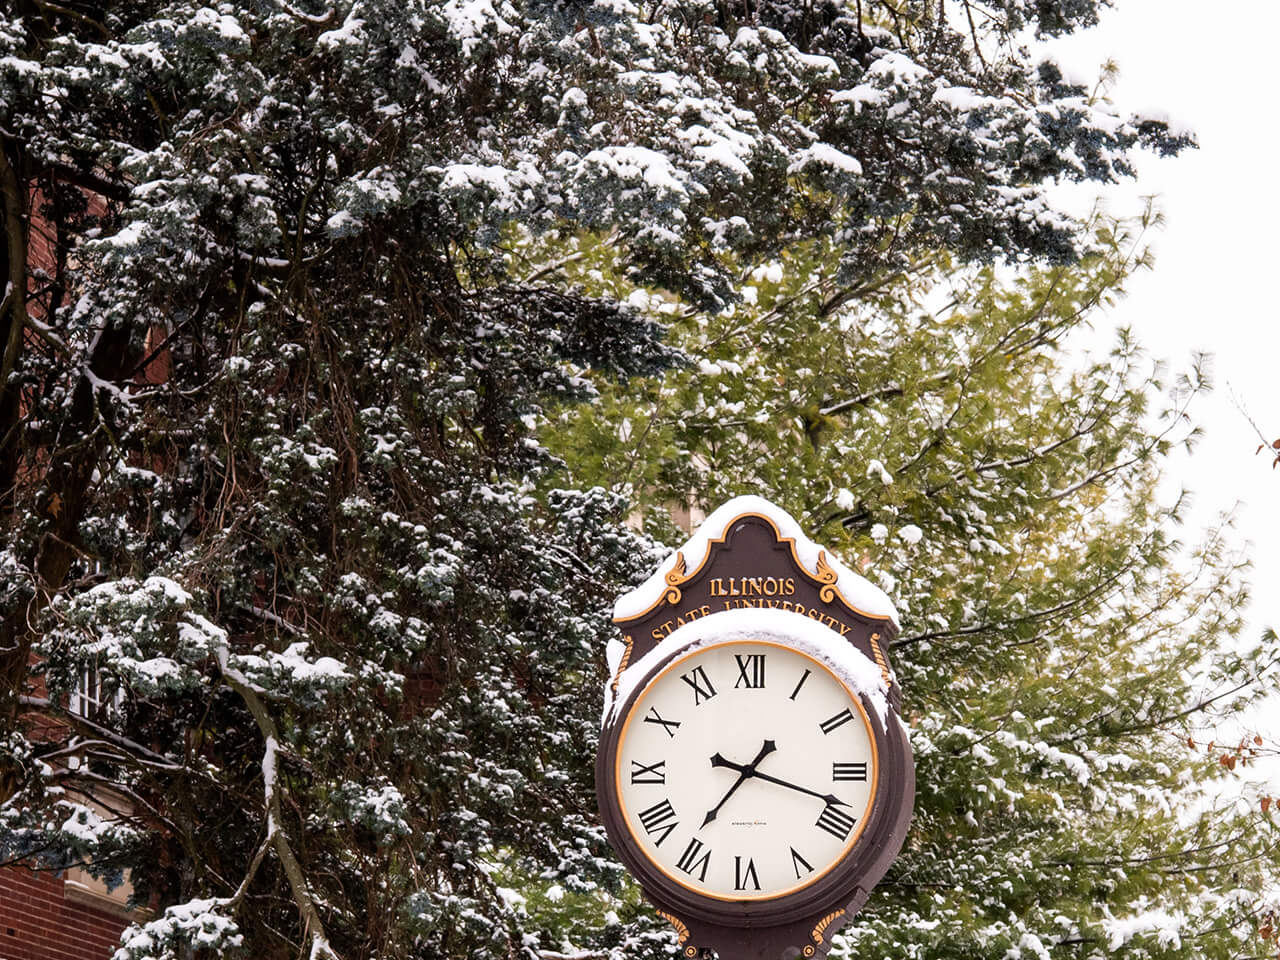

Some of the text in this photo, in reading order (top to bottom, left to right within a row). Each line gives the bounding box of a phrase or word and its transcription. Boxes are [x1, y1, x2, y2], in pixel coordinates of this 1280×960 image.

[709, 577, 796, 597] ILLINOIS
[651, 604, 711, 643] STATE
[680, 665, 718, 706] XI
[734, 654, 767, 689] XII
[789, 669, 812, 701] I
[643, 706, 682, 738] X
[819, 708, 855, 735] II
[631, 759, 666, 785] IX
[832, 761, 868, 782] III
[637, 798, 679, 848] VIII
[815, 804, 857, 842] IIII
[674, 837, 712, 883] VII
[734, 855, 762, 891] VI
[789, 846, 815, 879] V
